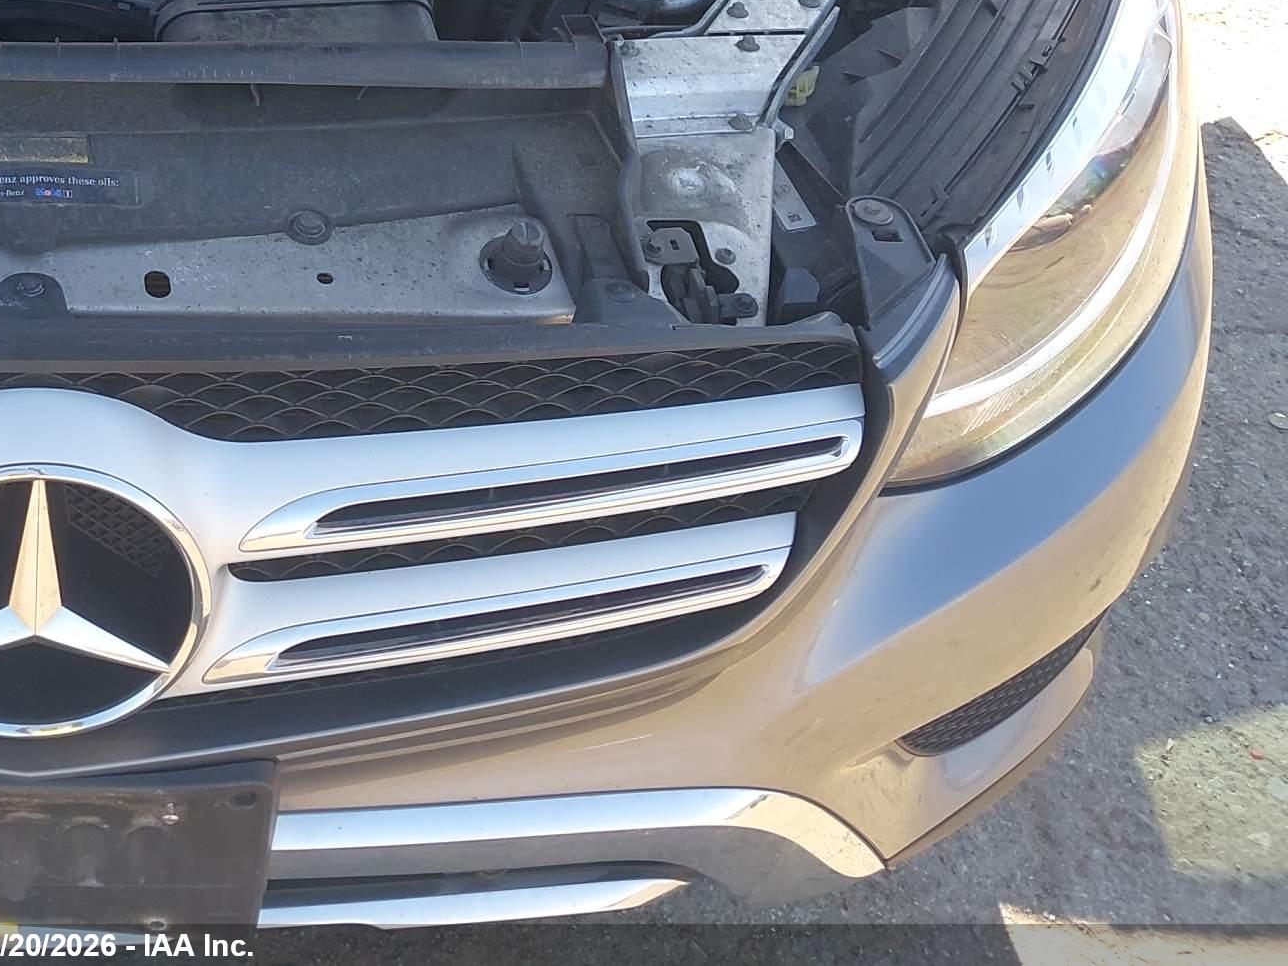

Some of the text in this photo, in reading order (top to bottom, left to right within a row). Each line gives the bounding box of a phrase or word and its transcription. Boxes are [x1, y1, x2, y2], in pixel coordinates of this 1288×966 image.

[19, 175, 65, 185] approves
[68, 176, 96, 185] these
[98, 177, 119, 186] oils:
